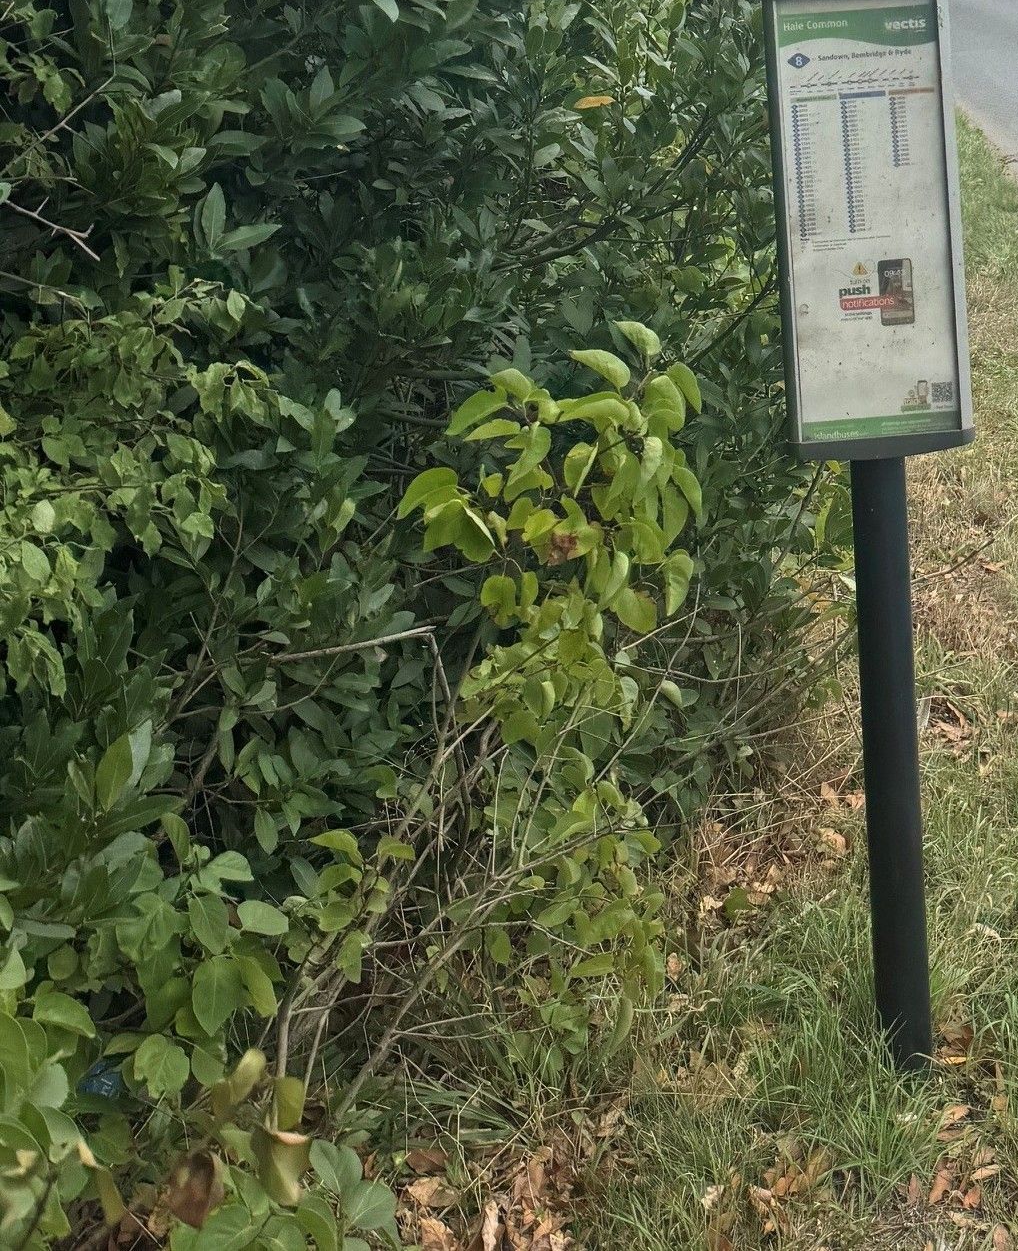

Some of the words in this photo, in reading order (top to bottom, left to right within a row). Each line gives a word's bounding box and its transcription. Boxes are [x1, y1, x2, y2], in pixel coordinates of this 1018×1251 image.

[783, 19, 805, 31] Hale
[807, 18, 848, 30] Common
[885, 17, 926, 30] vectis
[795, 56, 803, 67] 8
[817, 53, 850, 63] Sandown,
[895, 48, 912, 57] Ryde
[838, 284, 872, 297] push
[841, 295, 896, 309] notifications
